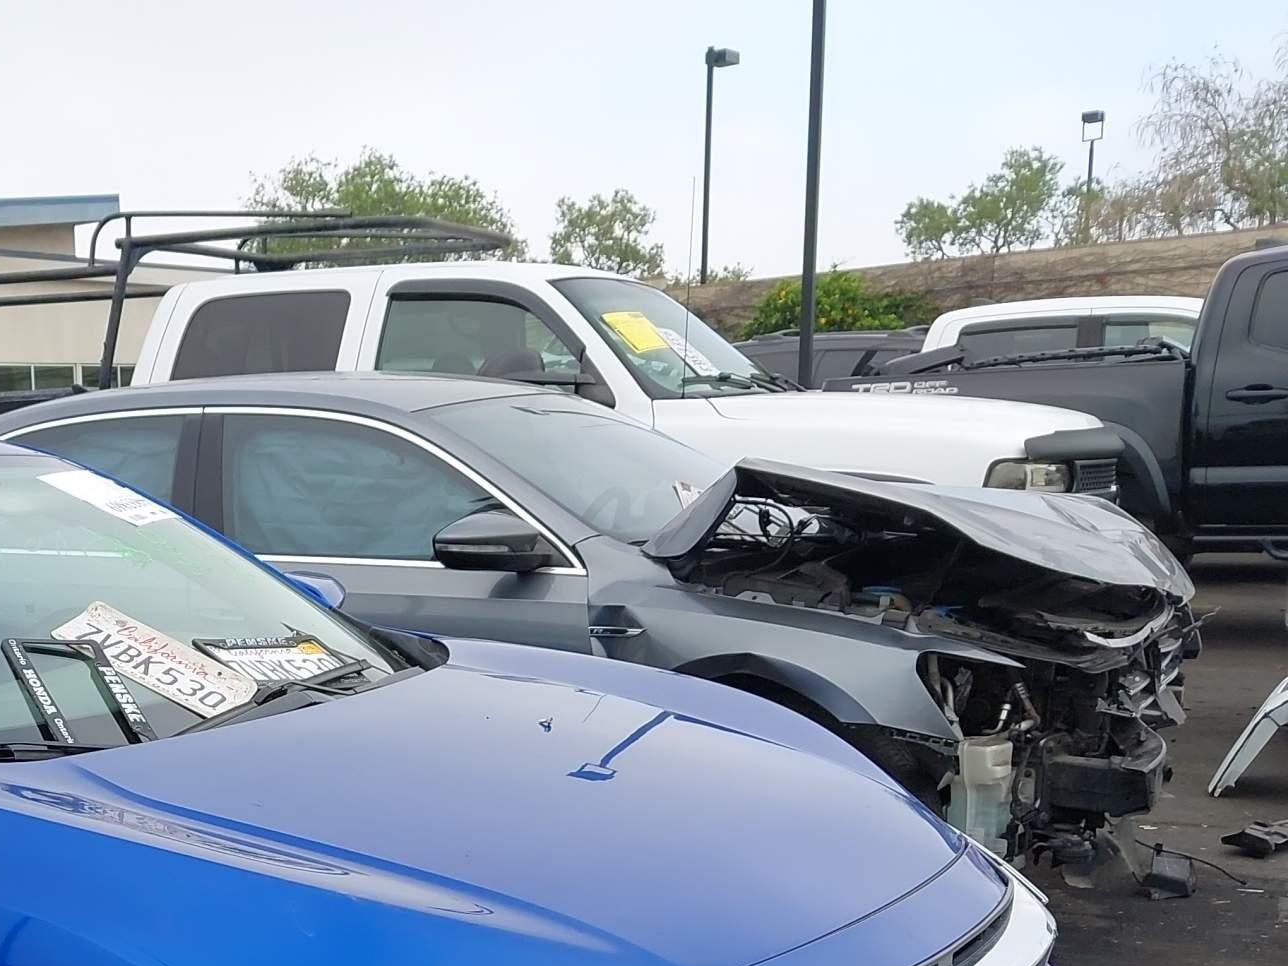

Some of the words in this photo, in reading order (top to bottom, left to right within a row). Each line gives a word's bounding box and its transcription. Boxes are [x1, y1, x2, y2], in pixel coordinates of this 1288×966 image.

[852, 381, 912, 393] TRD
[914, 380, 949, 388] OFF
[8, 639, 27, 665] Ontario
[22, 668, 58, 715] HONDA
[75, 622, 228, 709] 7VBK530
[116, 624, 217, 684] California
[98, 666, 147, 724] PENSKE
